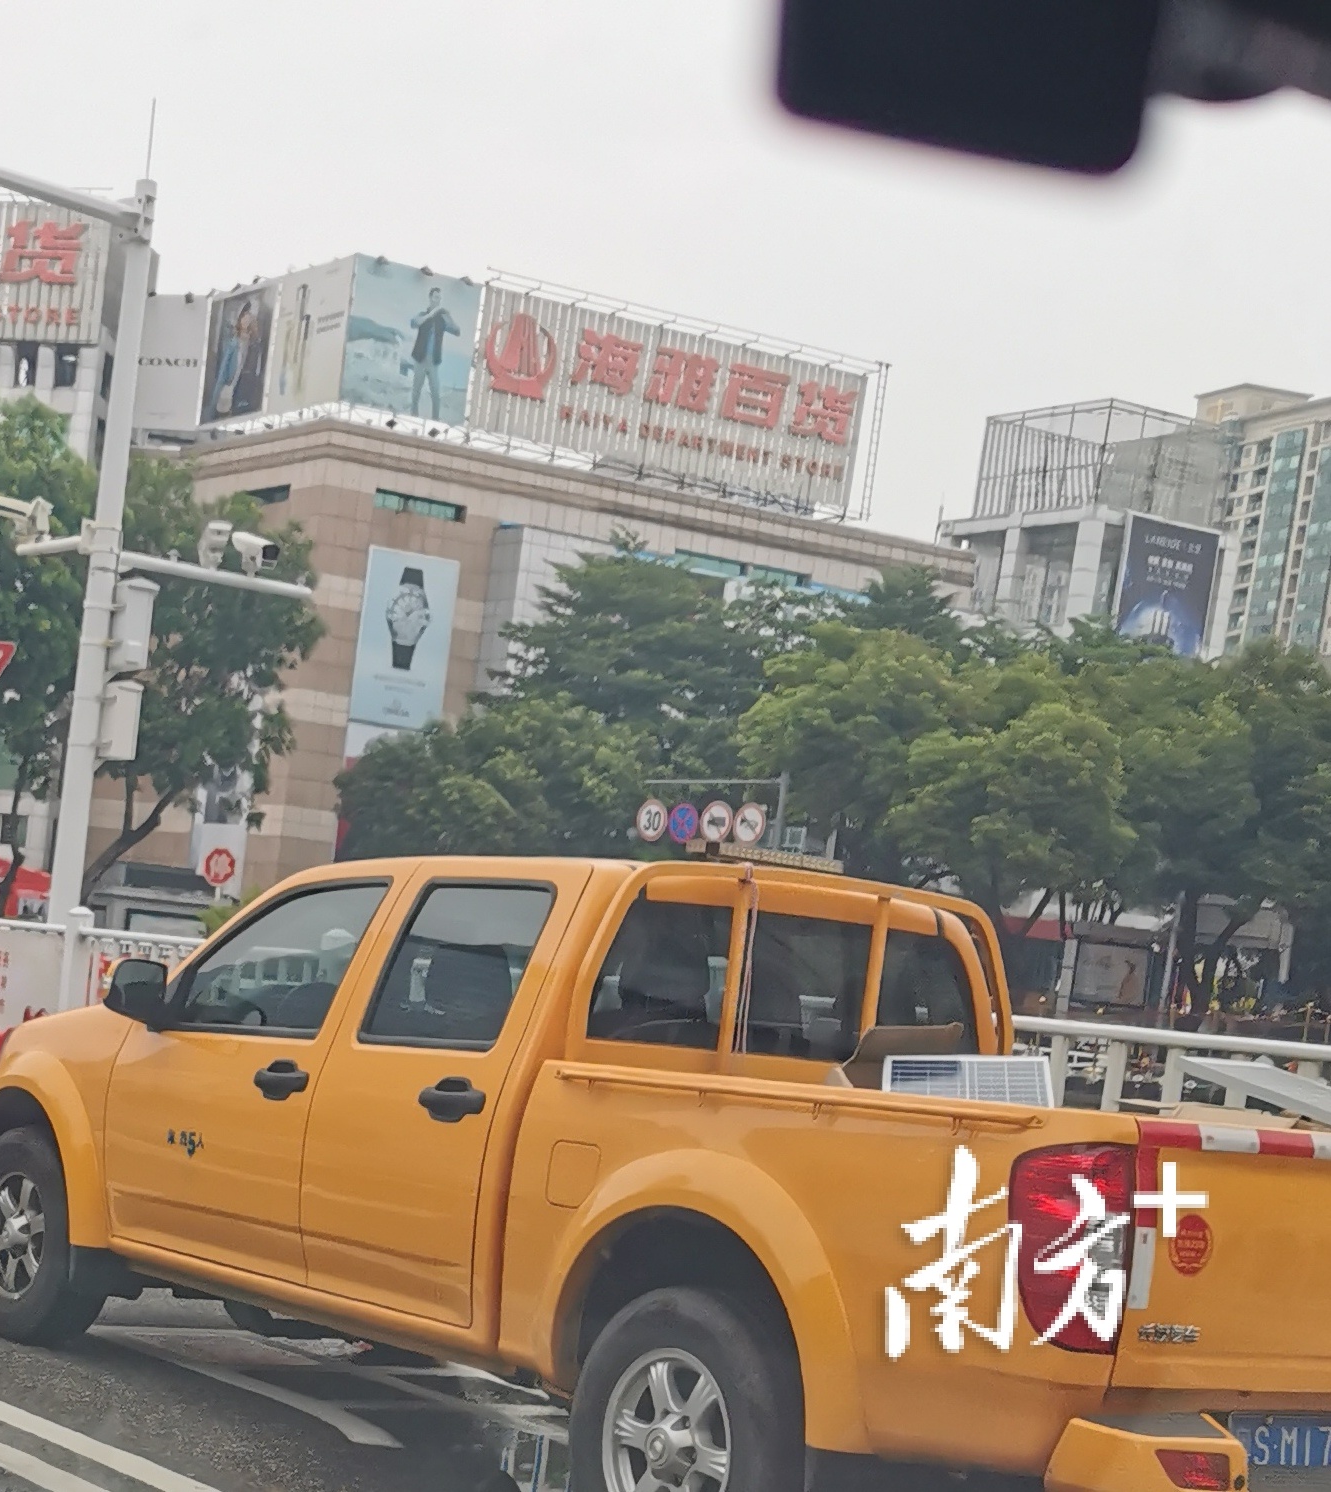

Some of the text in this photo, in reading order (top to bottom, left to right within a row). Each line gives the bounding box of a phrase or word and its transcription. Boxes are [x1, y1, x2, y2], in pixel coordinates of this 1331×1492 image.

[138, 357, 198, 368] COACH
[570, 327, 858, 446] 海雅百货
[559, 404, 845, 482] HAIYA DEPARTMENT STORE
[643, 808, 662, 832] 30
